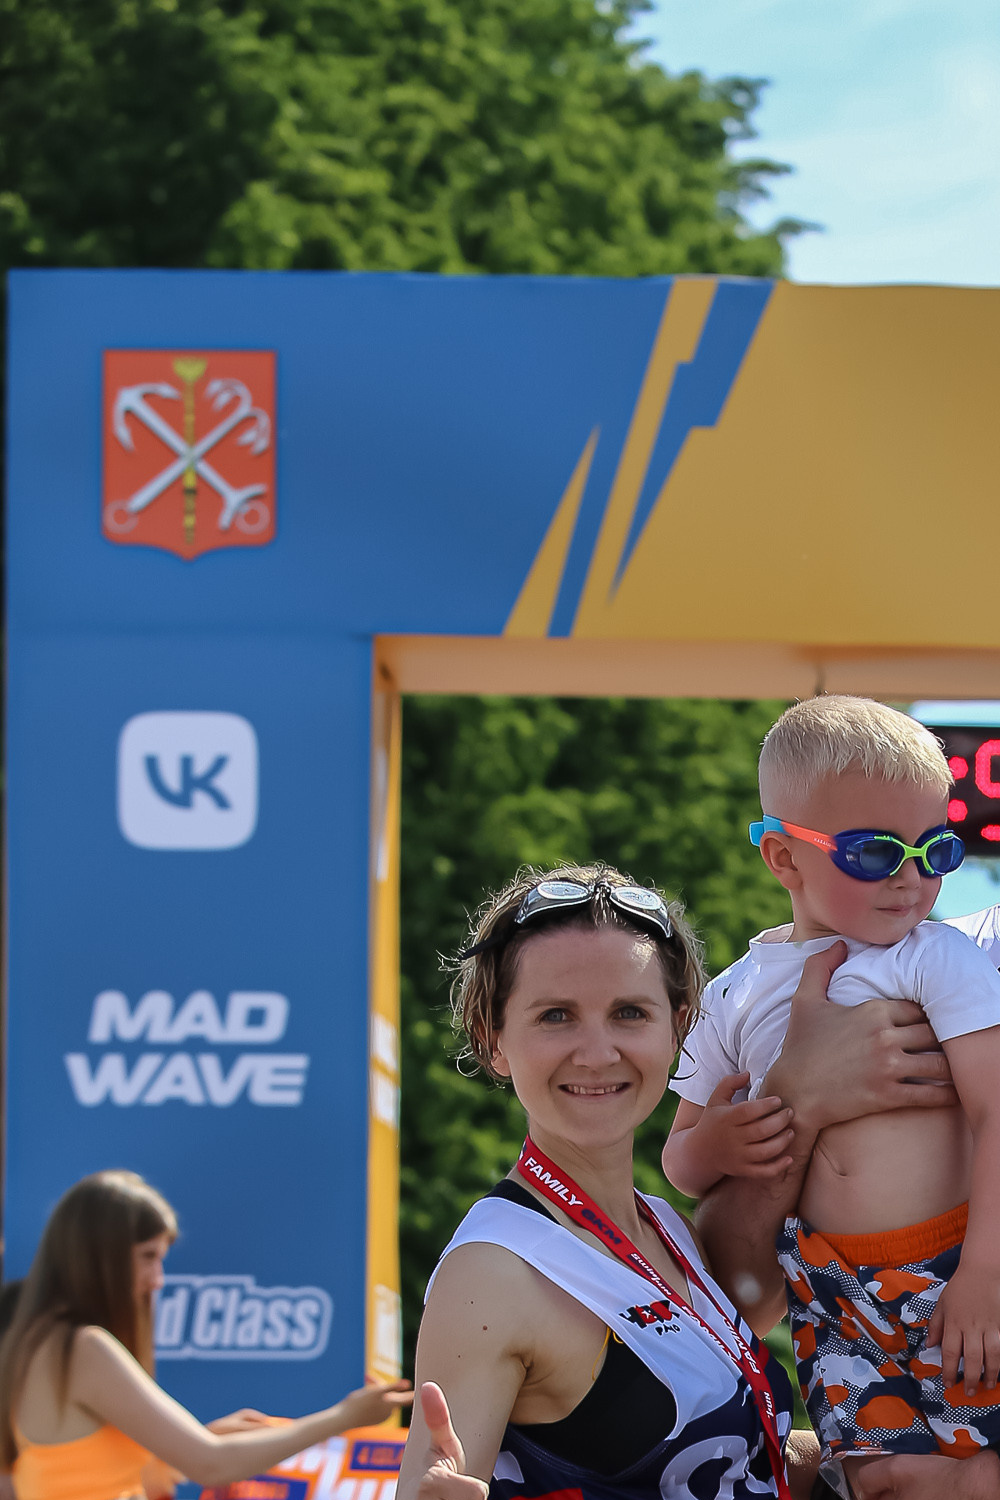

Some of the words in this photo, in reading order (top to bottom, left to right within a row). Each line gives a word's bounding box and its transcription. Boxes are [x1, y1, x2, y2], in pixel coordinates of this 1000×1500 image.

[144, 754, 233, 812] VK
[88, 990, 290, 1043] MAD
[64, 1053, 309, 1106] WAVE
[524, 1156, 584, 1208] FAMILY
[193, 1286, 319, 1348] Class
